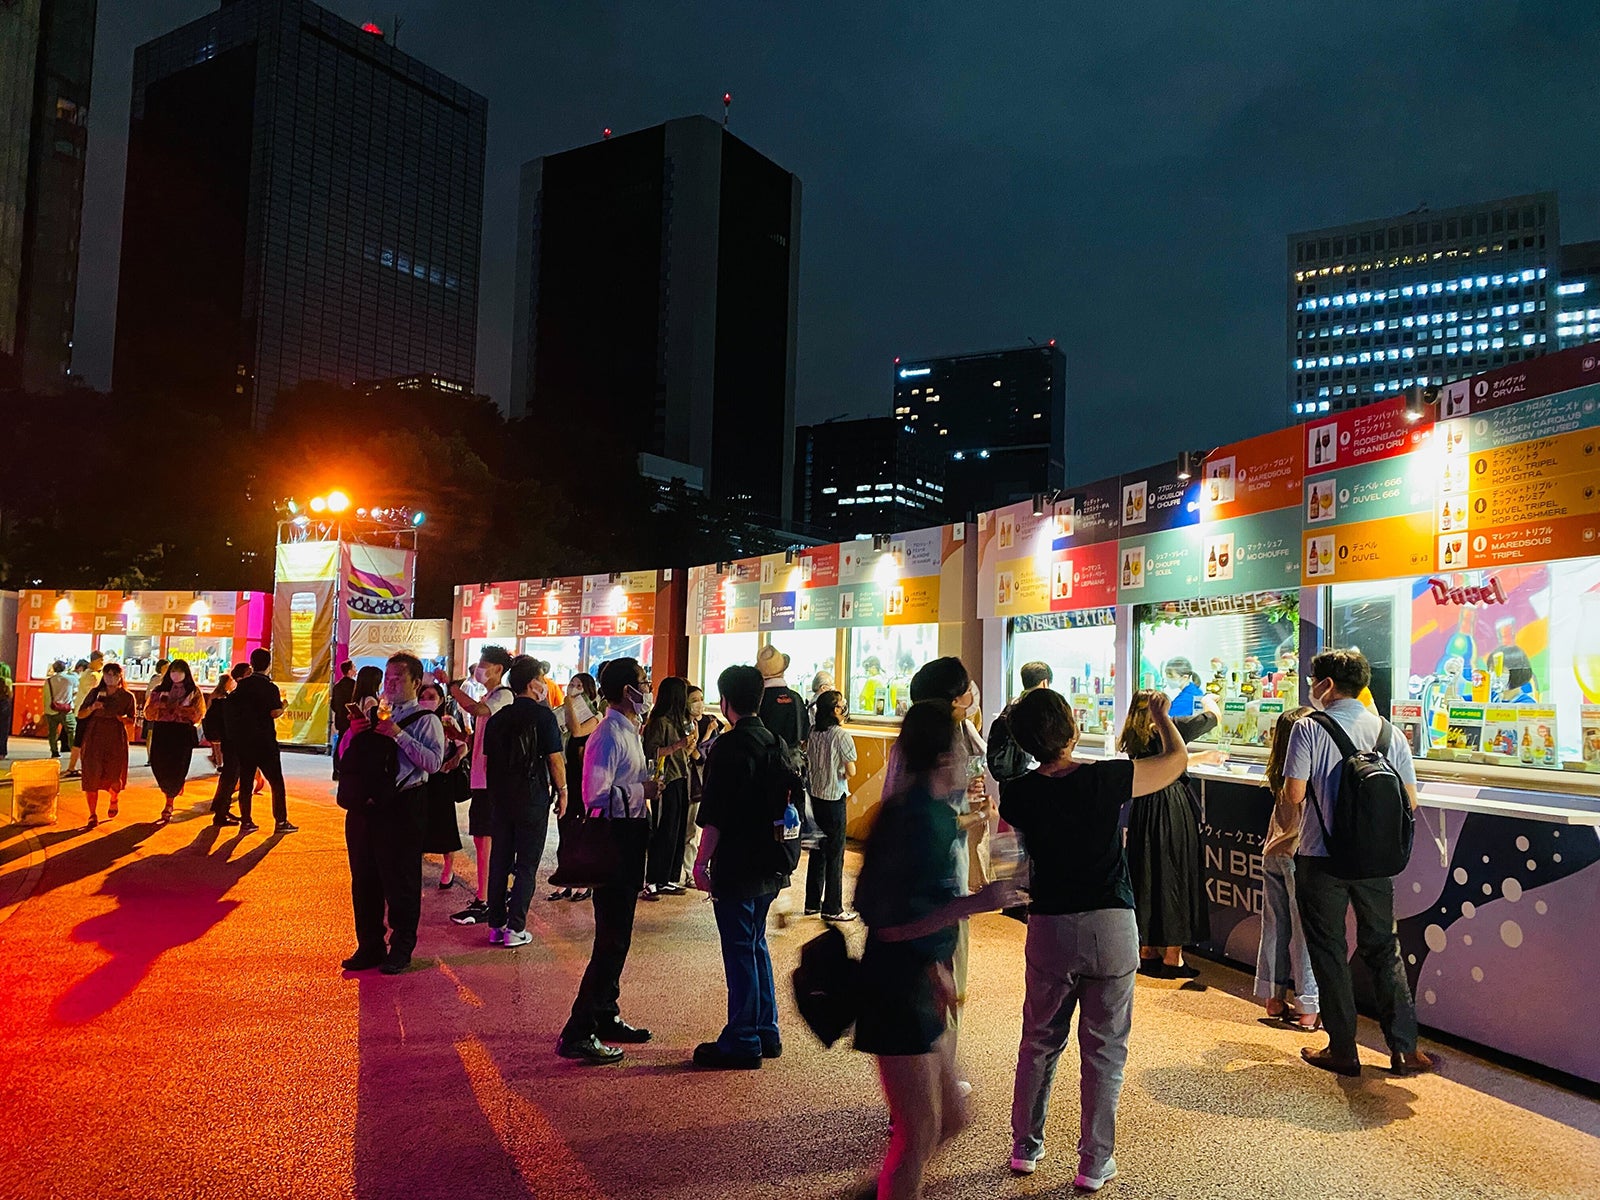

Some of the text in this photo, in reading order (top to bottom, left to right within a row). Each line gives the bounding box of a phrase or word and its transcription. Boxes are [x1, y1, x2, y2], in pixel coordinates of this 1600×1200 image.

[1492, 384, 1527, 398] ORVAL
[1492, 411, 1582, 438] GOUDEN CAROLUS
[1353, 428, 1409, 447] RODENBACH
[1492, 421, 1580, 446] WHISKEY INFUSED
[1353, 438, 1405, 457] GRAND CRU
[1248, 467, 1291, 483] MAREDSOUS
[1492, 458, 1559, 476] DUVEL TRIPEL
[1492, 470, 1543, 485] HOP CITRA
[1352, 488, 1400, 504] DUVEL 666
[1492, 499, 1559, 516] DUVEL TRIPEL
[1492, 507, 1568, 525] HOP CASHMERE
[1491, 537, 1552, 550] MAREDSOUS
[1257, 549, 1290, 560] CHOUFFE
[1351, 553, 1380, 563] DUVEL
[1491, 550, 1524, 560] TRIPEL
[1428, 576, 1508, 606] Duvel
[1075, 608, 1115, 626] EXTRA
